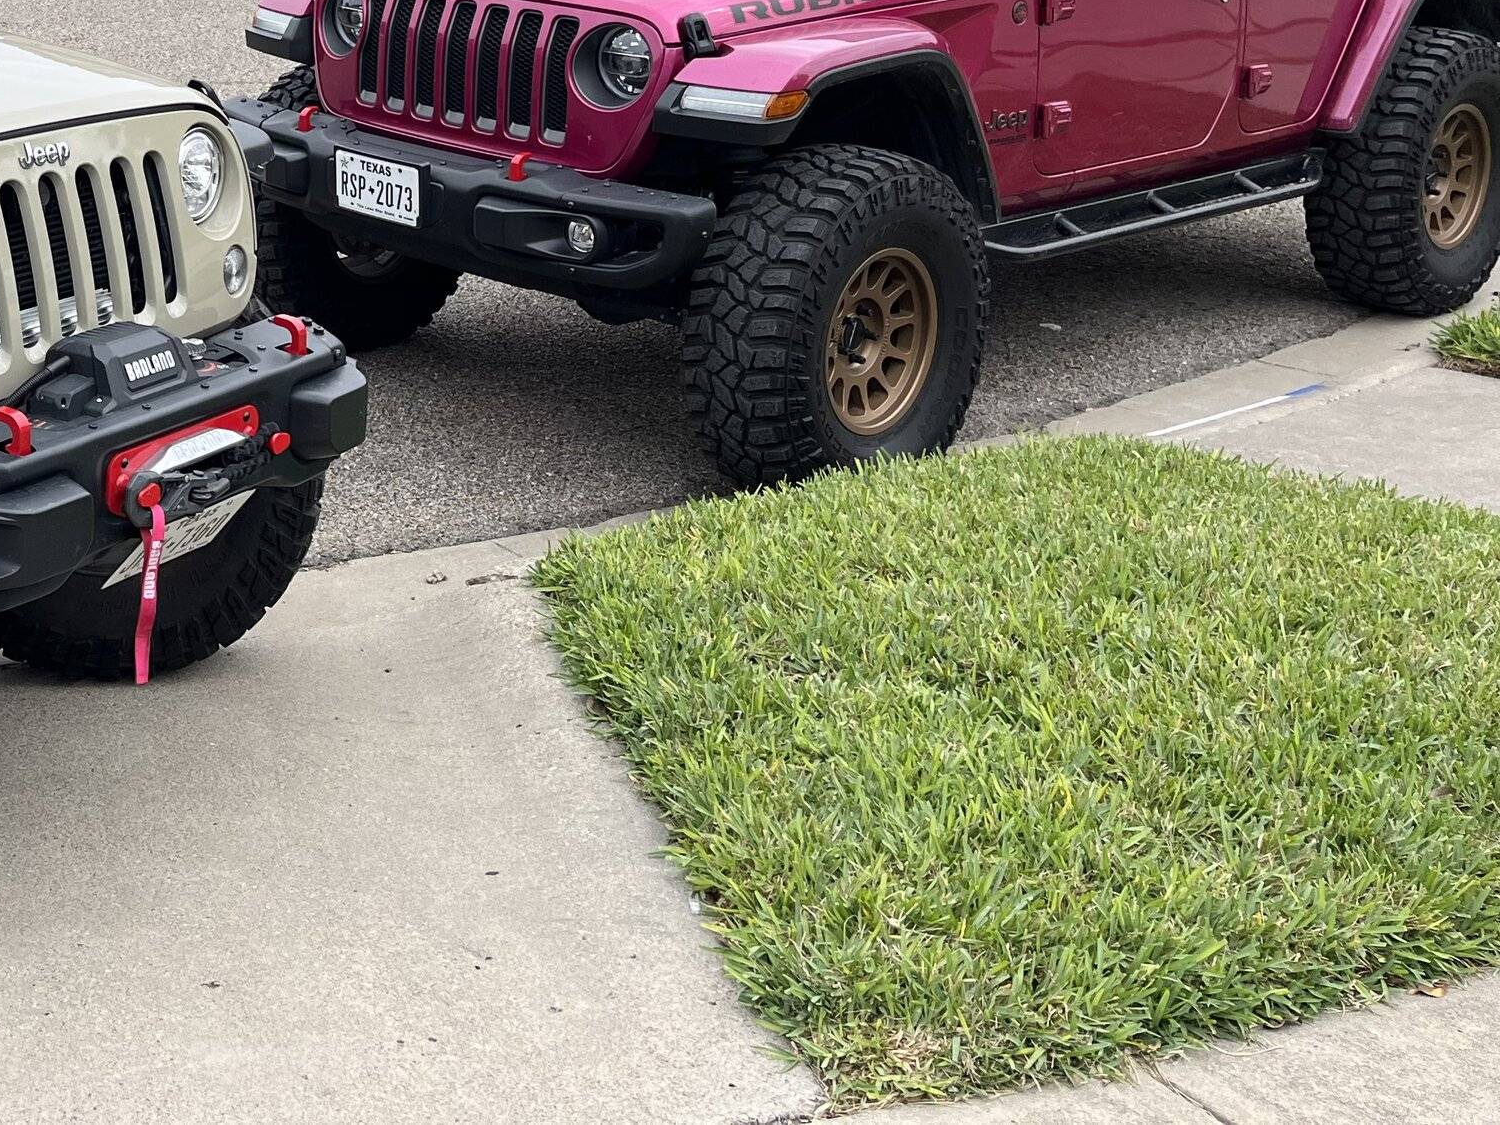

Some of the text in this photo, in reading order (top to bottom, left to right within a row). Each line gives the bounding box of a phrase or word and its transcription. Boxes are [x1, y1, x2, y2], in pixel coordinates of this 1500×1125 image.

[18, 140, 71, 170] Jeep
[359, 159, 392, 177] TEXAS
[124, 349, 176, 382] BADLAND
[143, 540, 163, 600] BADLAND
